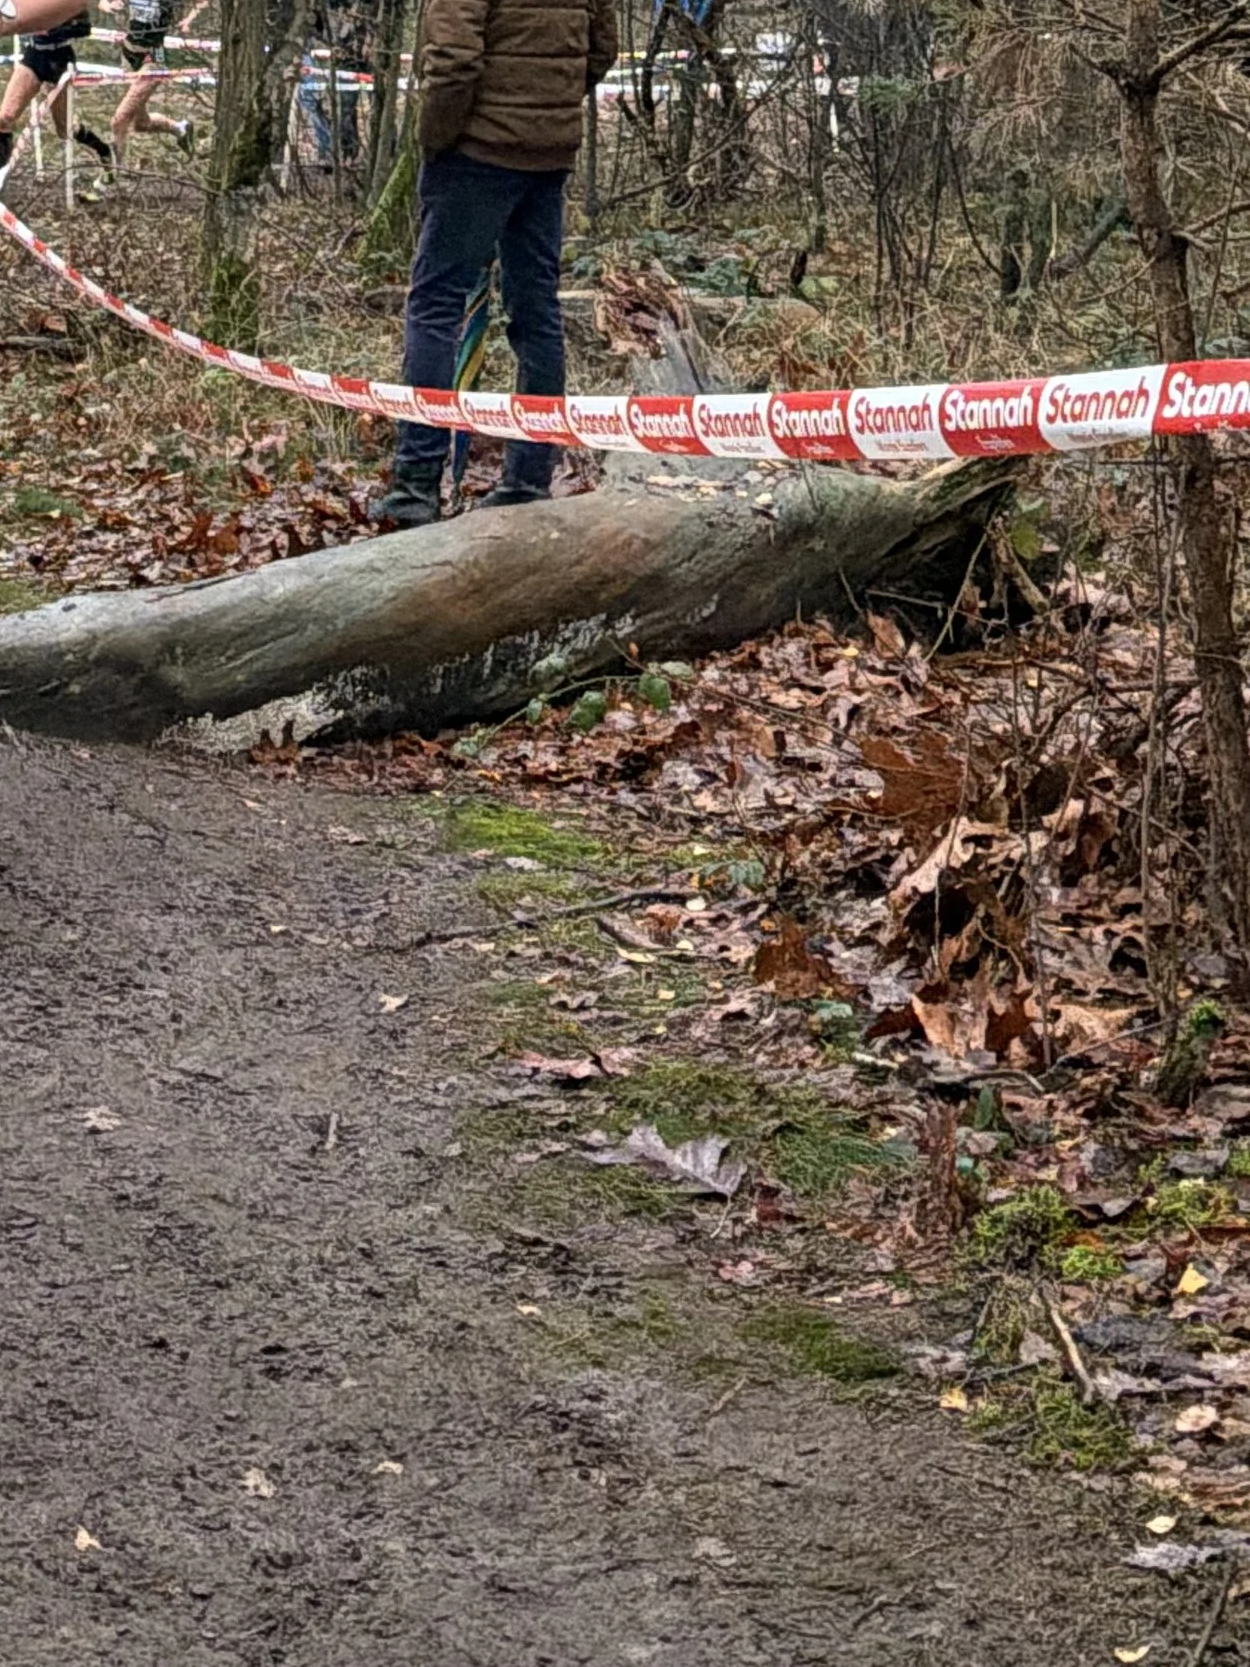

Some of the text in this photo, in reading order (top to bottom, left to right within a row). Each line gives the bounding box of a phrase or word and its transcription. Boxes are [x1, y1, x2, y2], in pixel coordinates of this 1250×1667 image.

[630, 403, 696, 438] Stannah
[698, 402, 767, 438] Stannah
[771, 397, 846, 438] Stannah
[855, 393, 934, 434] Stannah
[944, 385, 1033, 432] Stannah
[1047, 375, 1150, 425] Stannah
